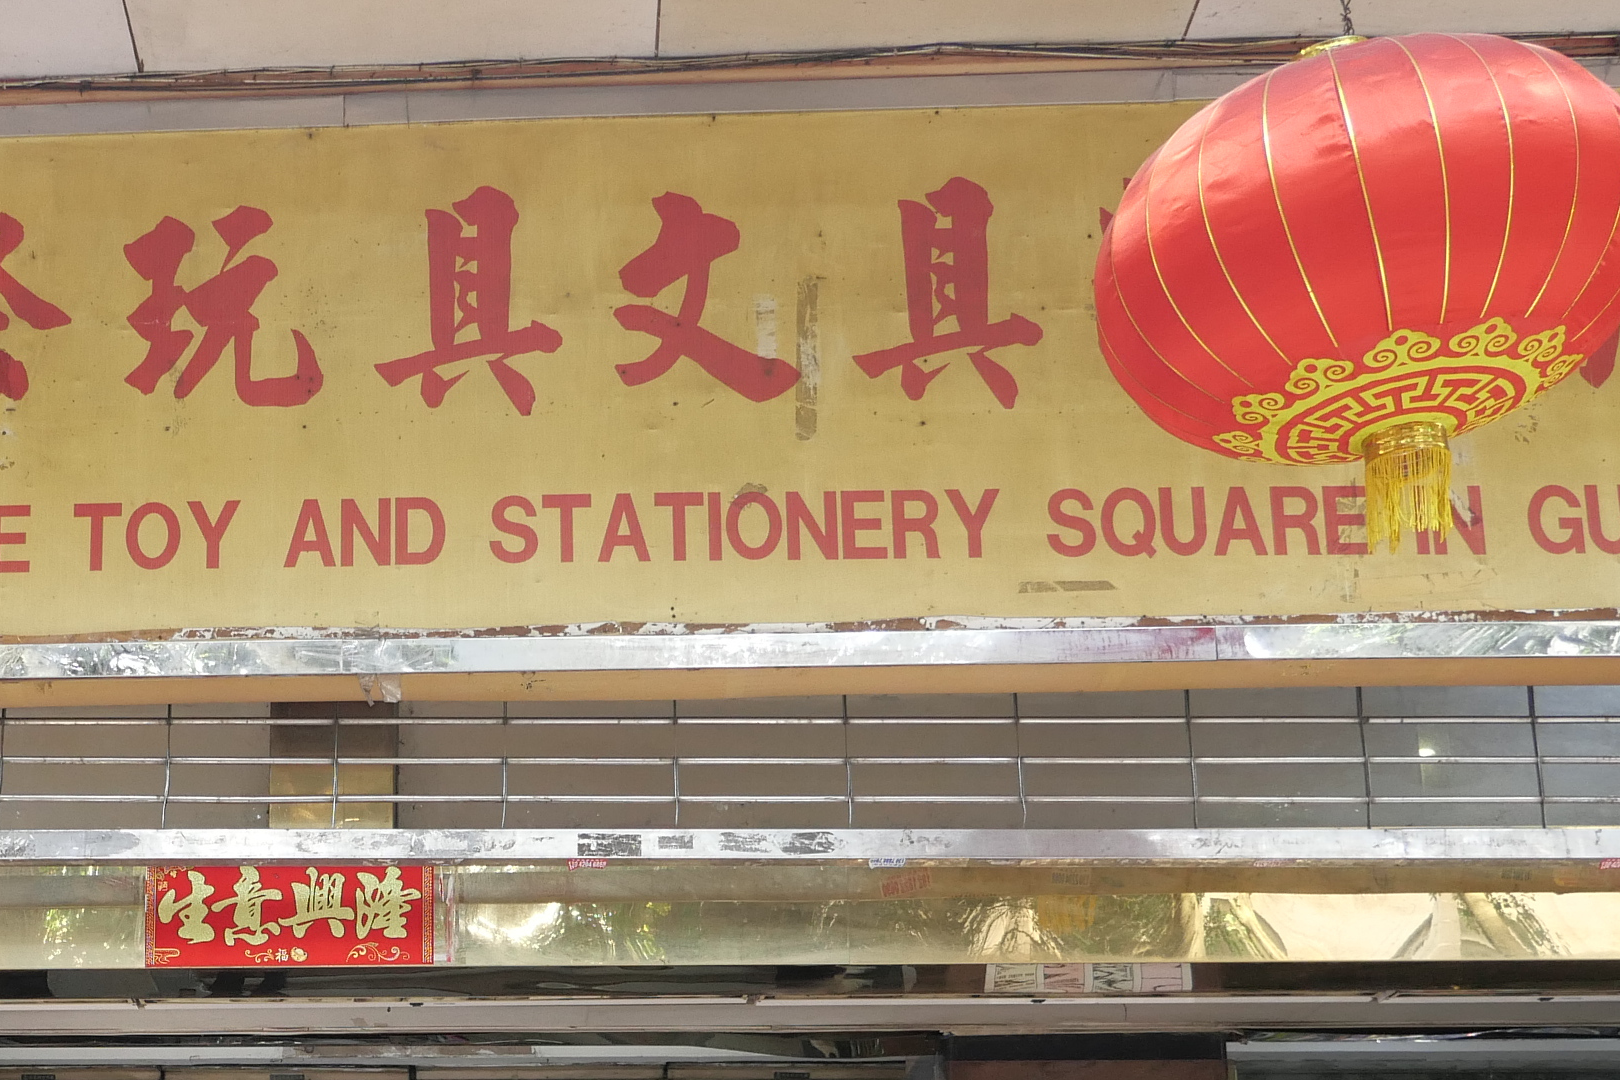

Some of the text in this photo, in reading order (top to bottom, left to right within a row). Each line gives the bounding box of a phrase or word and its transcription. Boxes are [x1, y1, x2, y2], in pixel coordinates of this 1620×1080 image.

[73, 499, 241, 571] TOY
[283, 496, 447, 569] AND
[488, 487, 1001, 564] STATIONERY
[1046, 485, 1369, 560] SQUARE
[157, 866, 422, 946] 生意興隆
